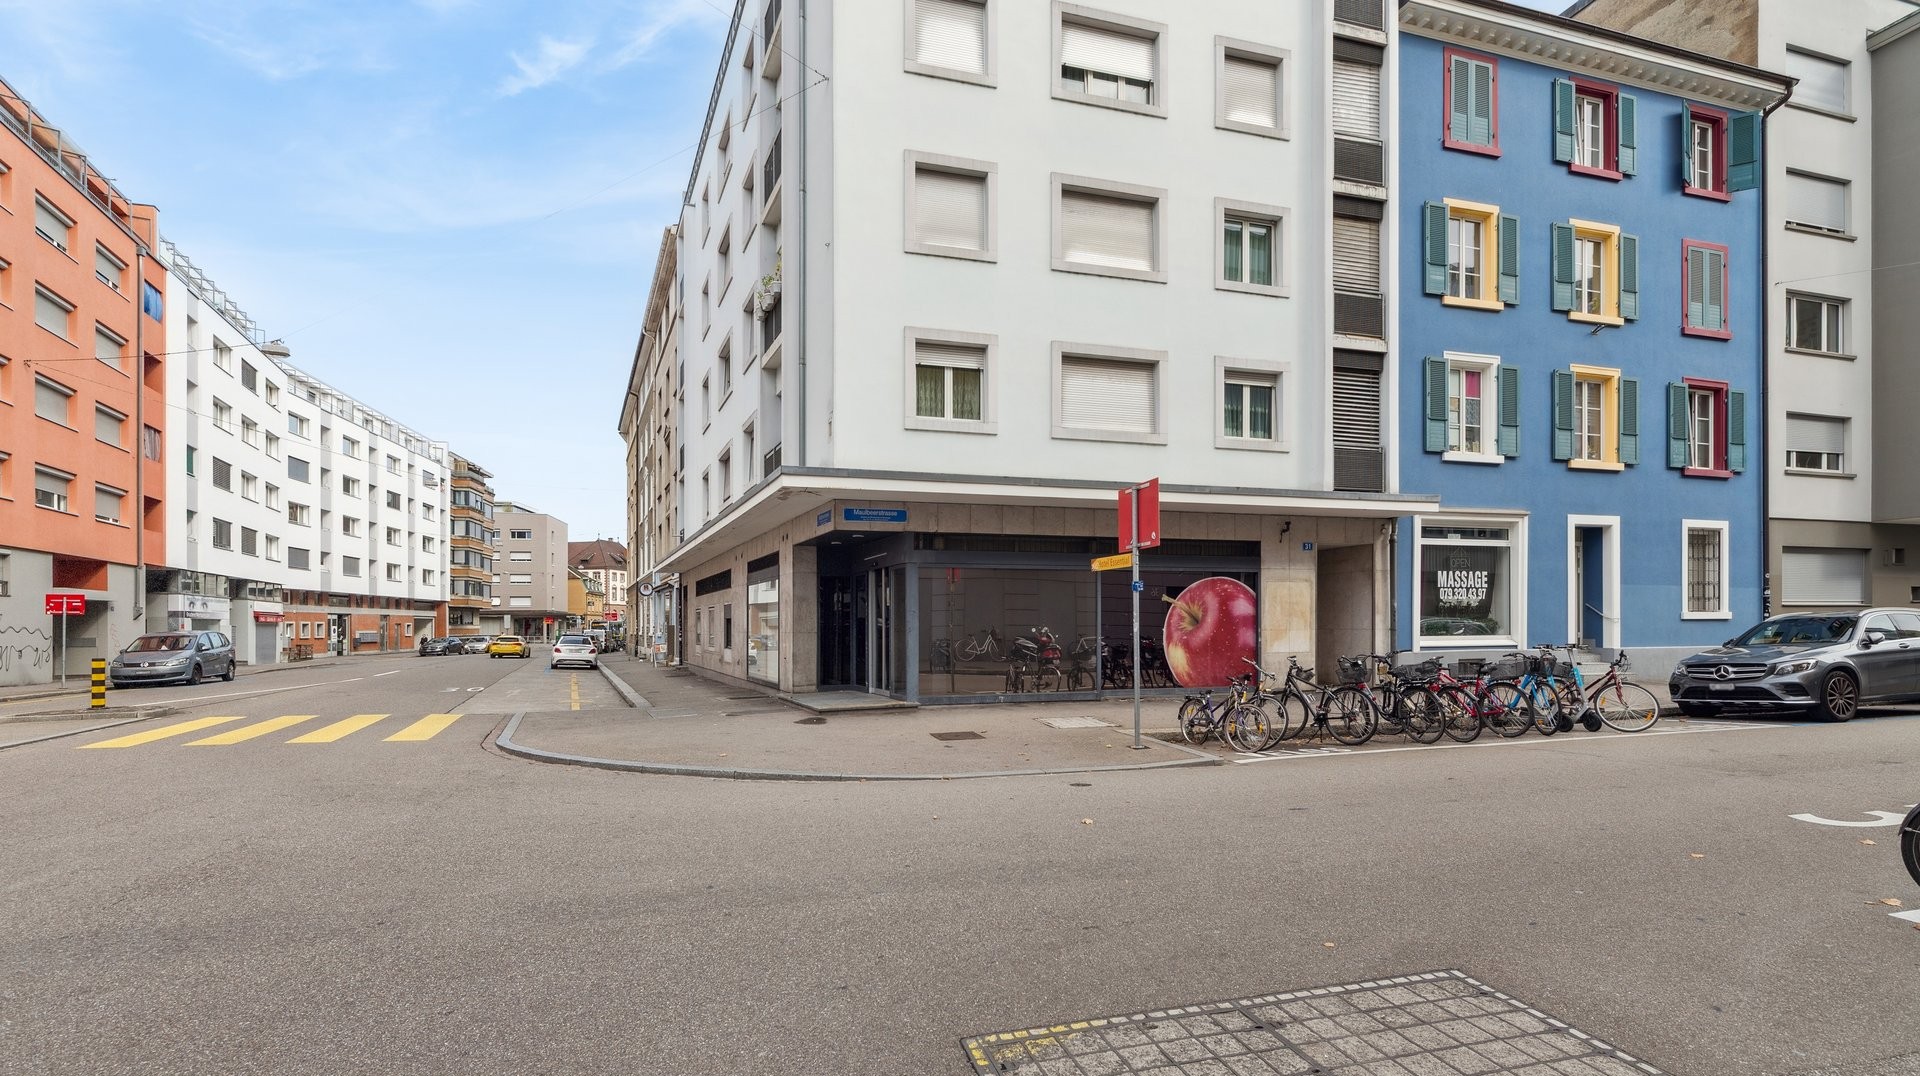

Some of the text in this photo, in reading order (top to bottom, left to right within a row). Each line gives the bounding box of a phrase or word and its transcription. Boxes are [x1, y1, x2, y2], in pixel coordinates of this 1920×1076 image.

[853, 509, 898, 517] Maulbeerstrasse
[1450, 558, 1471, 568] OPEN
[1437, 570, 1488, 588] MASSAGE
[1439, 587, 1487, 600] 079.320.43.97
